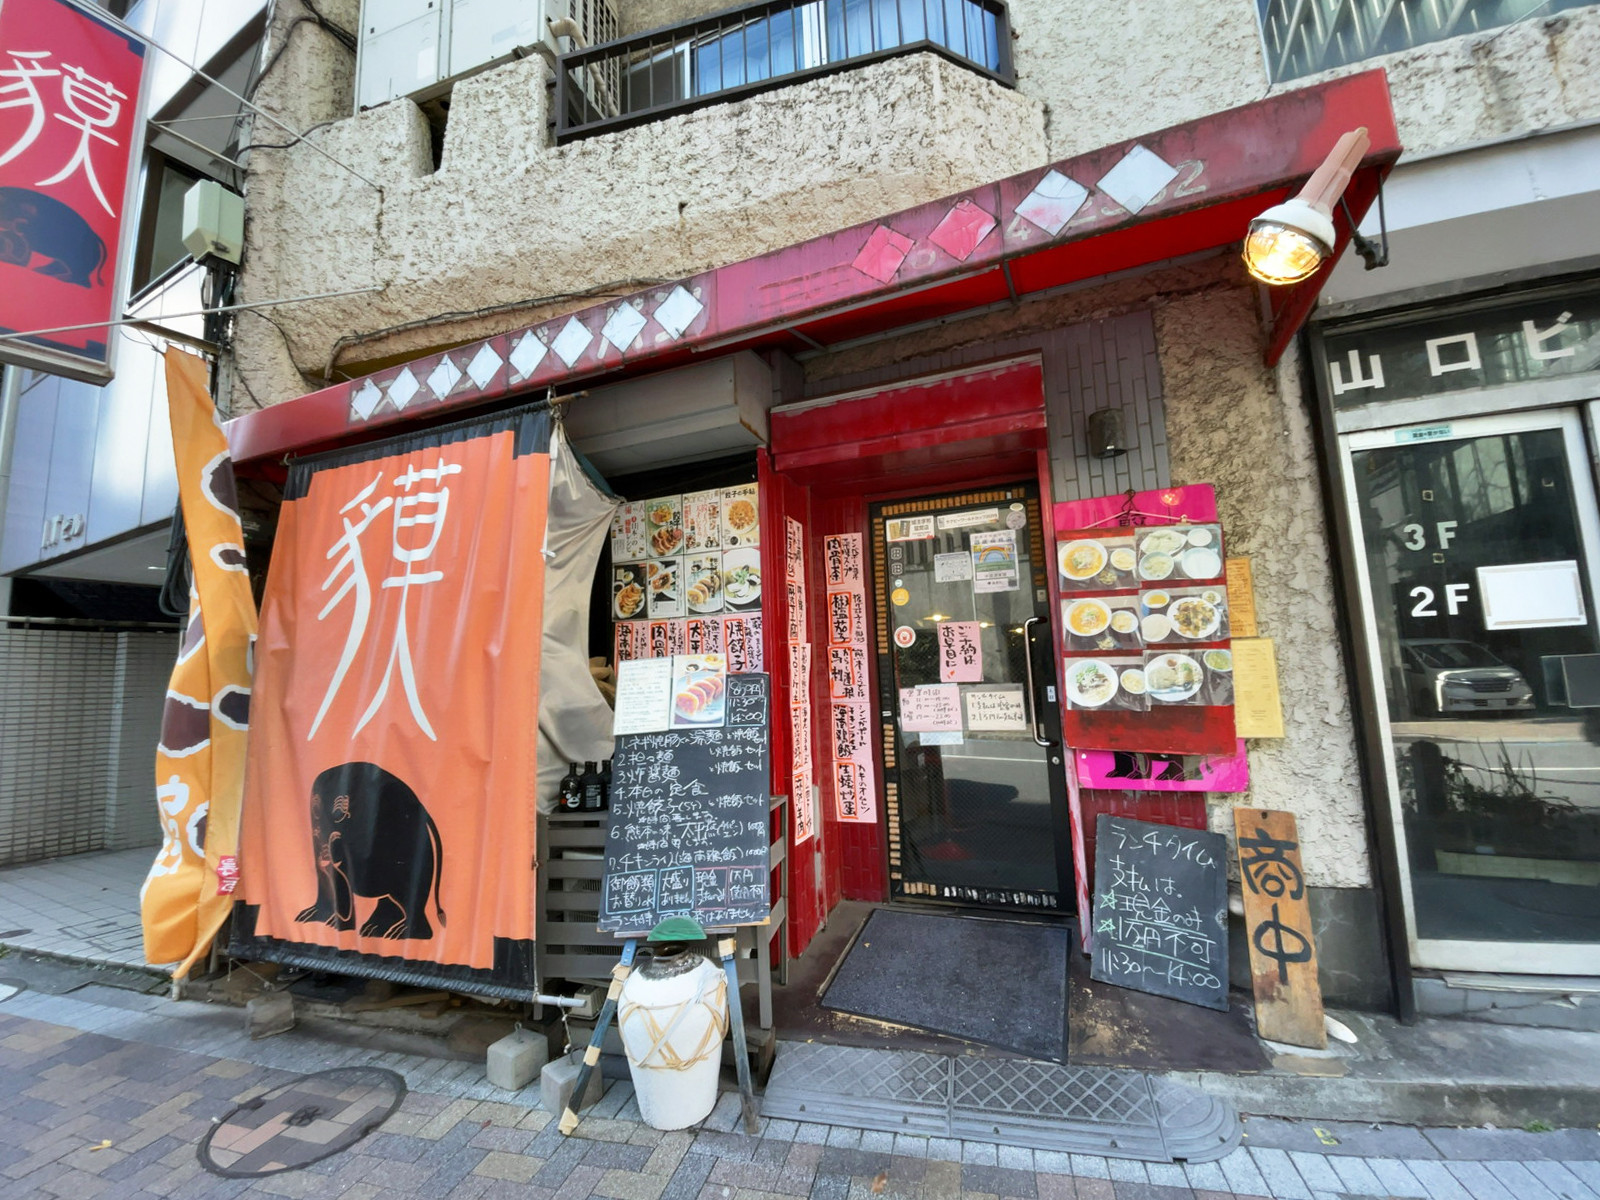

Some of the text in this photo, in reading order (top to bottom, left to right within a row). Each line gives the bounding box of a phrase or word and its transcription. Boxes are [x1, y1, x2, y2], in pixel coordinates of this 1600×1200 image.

[1404, 521, 1457, 551] 3F
[1409, 583, 1470, 617] 2F
[726, 621, 745, 670] 焼餃子
[1111, 824, 1216, 869] ランチタイム
[1118, 892, 1203, 929] 現金のみ
